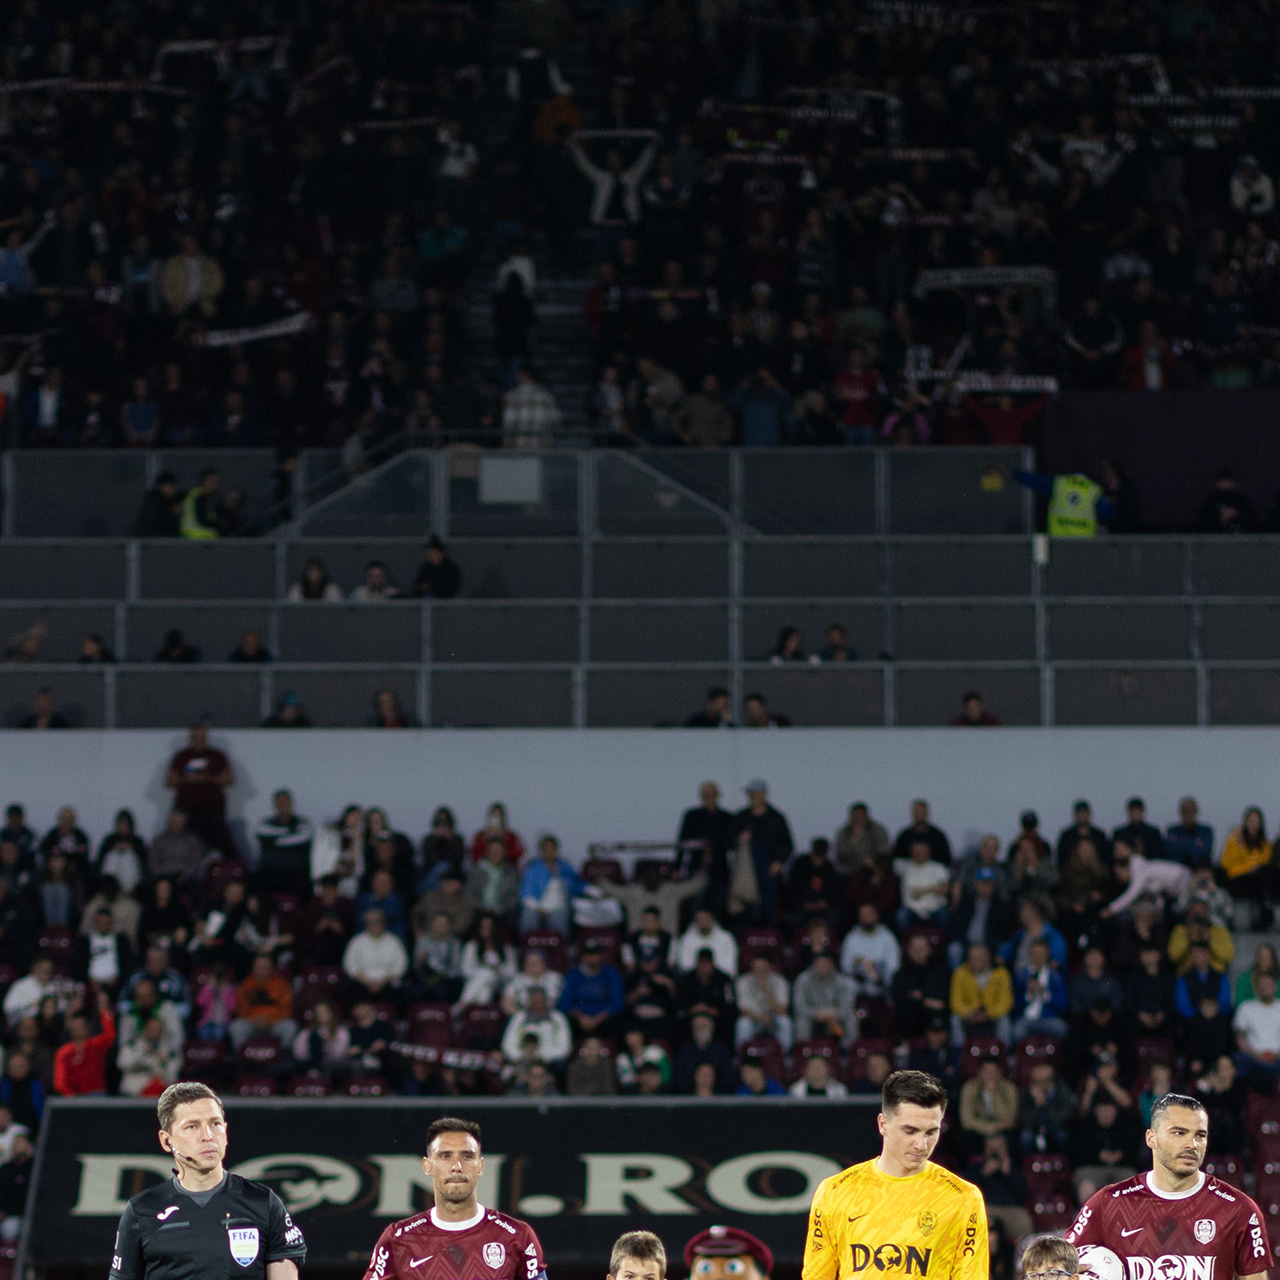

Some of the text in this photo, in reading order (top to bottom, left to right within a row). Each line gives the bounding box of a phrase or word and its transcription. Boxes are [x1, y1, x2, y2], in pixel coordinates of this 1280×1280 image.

[1214, 1190, 1236, 1202] avinto
[404, 1217, 427, 1232] avinto
[494, 1218, 516, 1234] avinto
[813, 1208, 823, 1238] DSC
[1074, 1205, 1092, 1236] DSC
[232, 1231, 256, 1241] FIFA
[963, 1227, 976, 1257] DSC
[1251, 1227, 1266, 1259] DSC
[375, 1246, 390, 1277] DSC
[850, 1243, 933, 1277] DON
